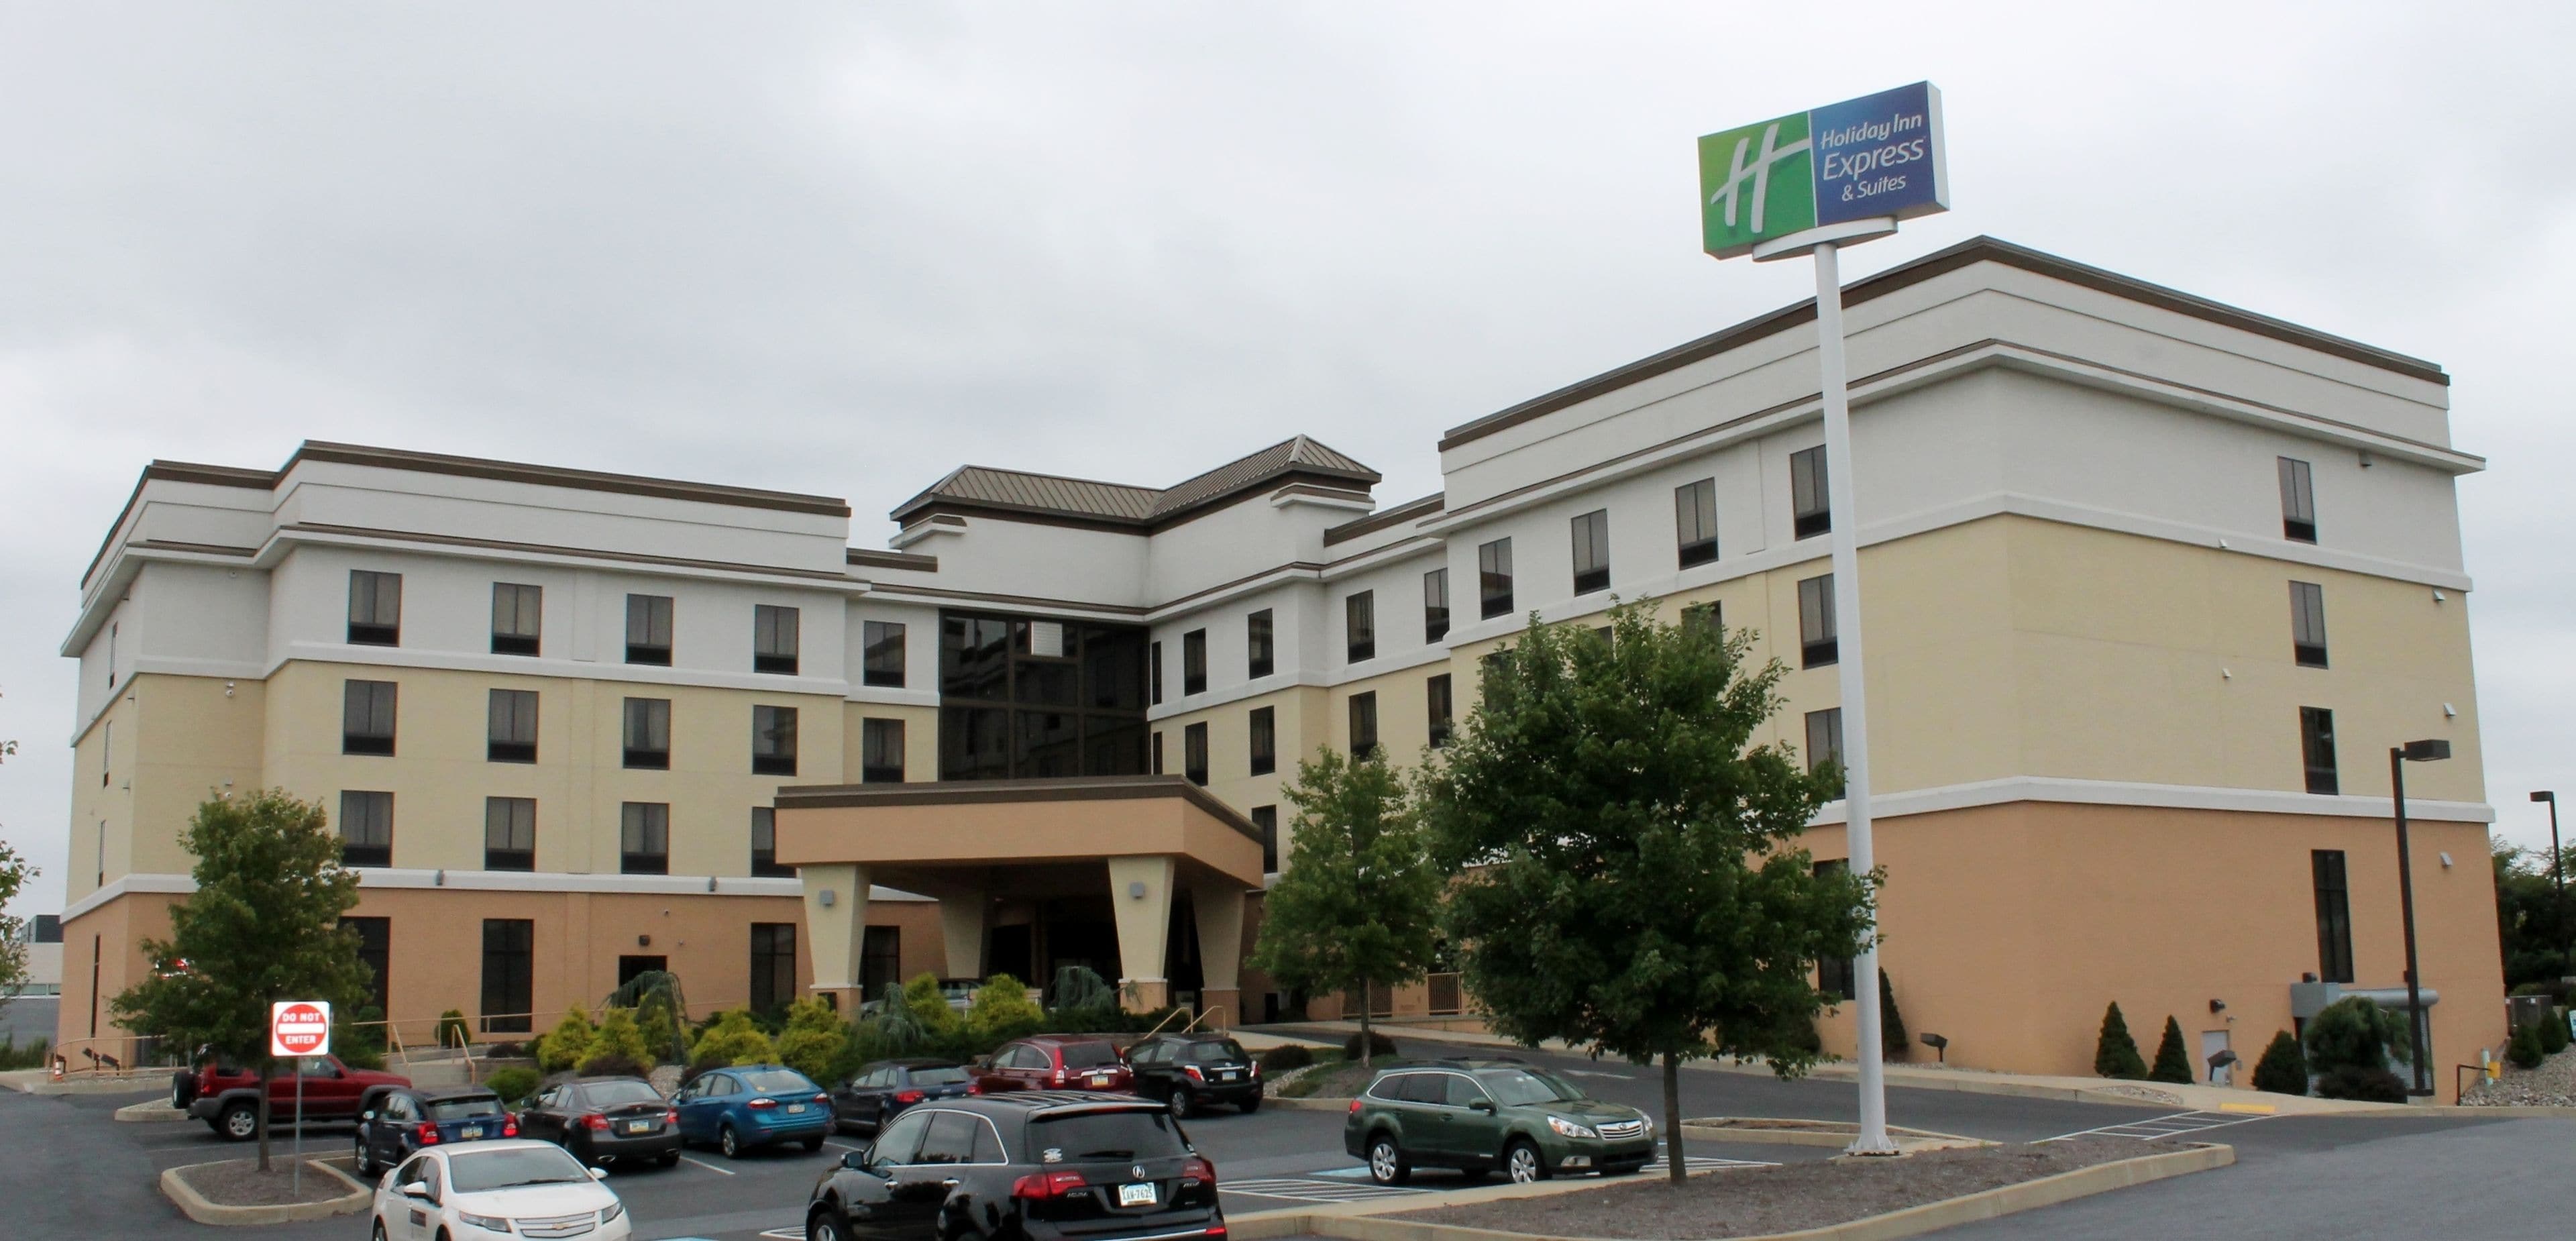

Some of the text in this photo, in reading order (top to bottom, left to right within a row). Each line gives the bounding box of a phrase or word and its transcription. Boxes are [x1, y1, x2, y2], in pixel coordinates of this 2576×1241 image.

[1821, 113, 1922, 150] Holiday Inn
[1823, 139, 1924, 180] Express
[1841, 176, 1907, 201] & Suites
[282, 1012, 320, 1022] DO NOT
[285, 1034, 317, 1044] ENTER
